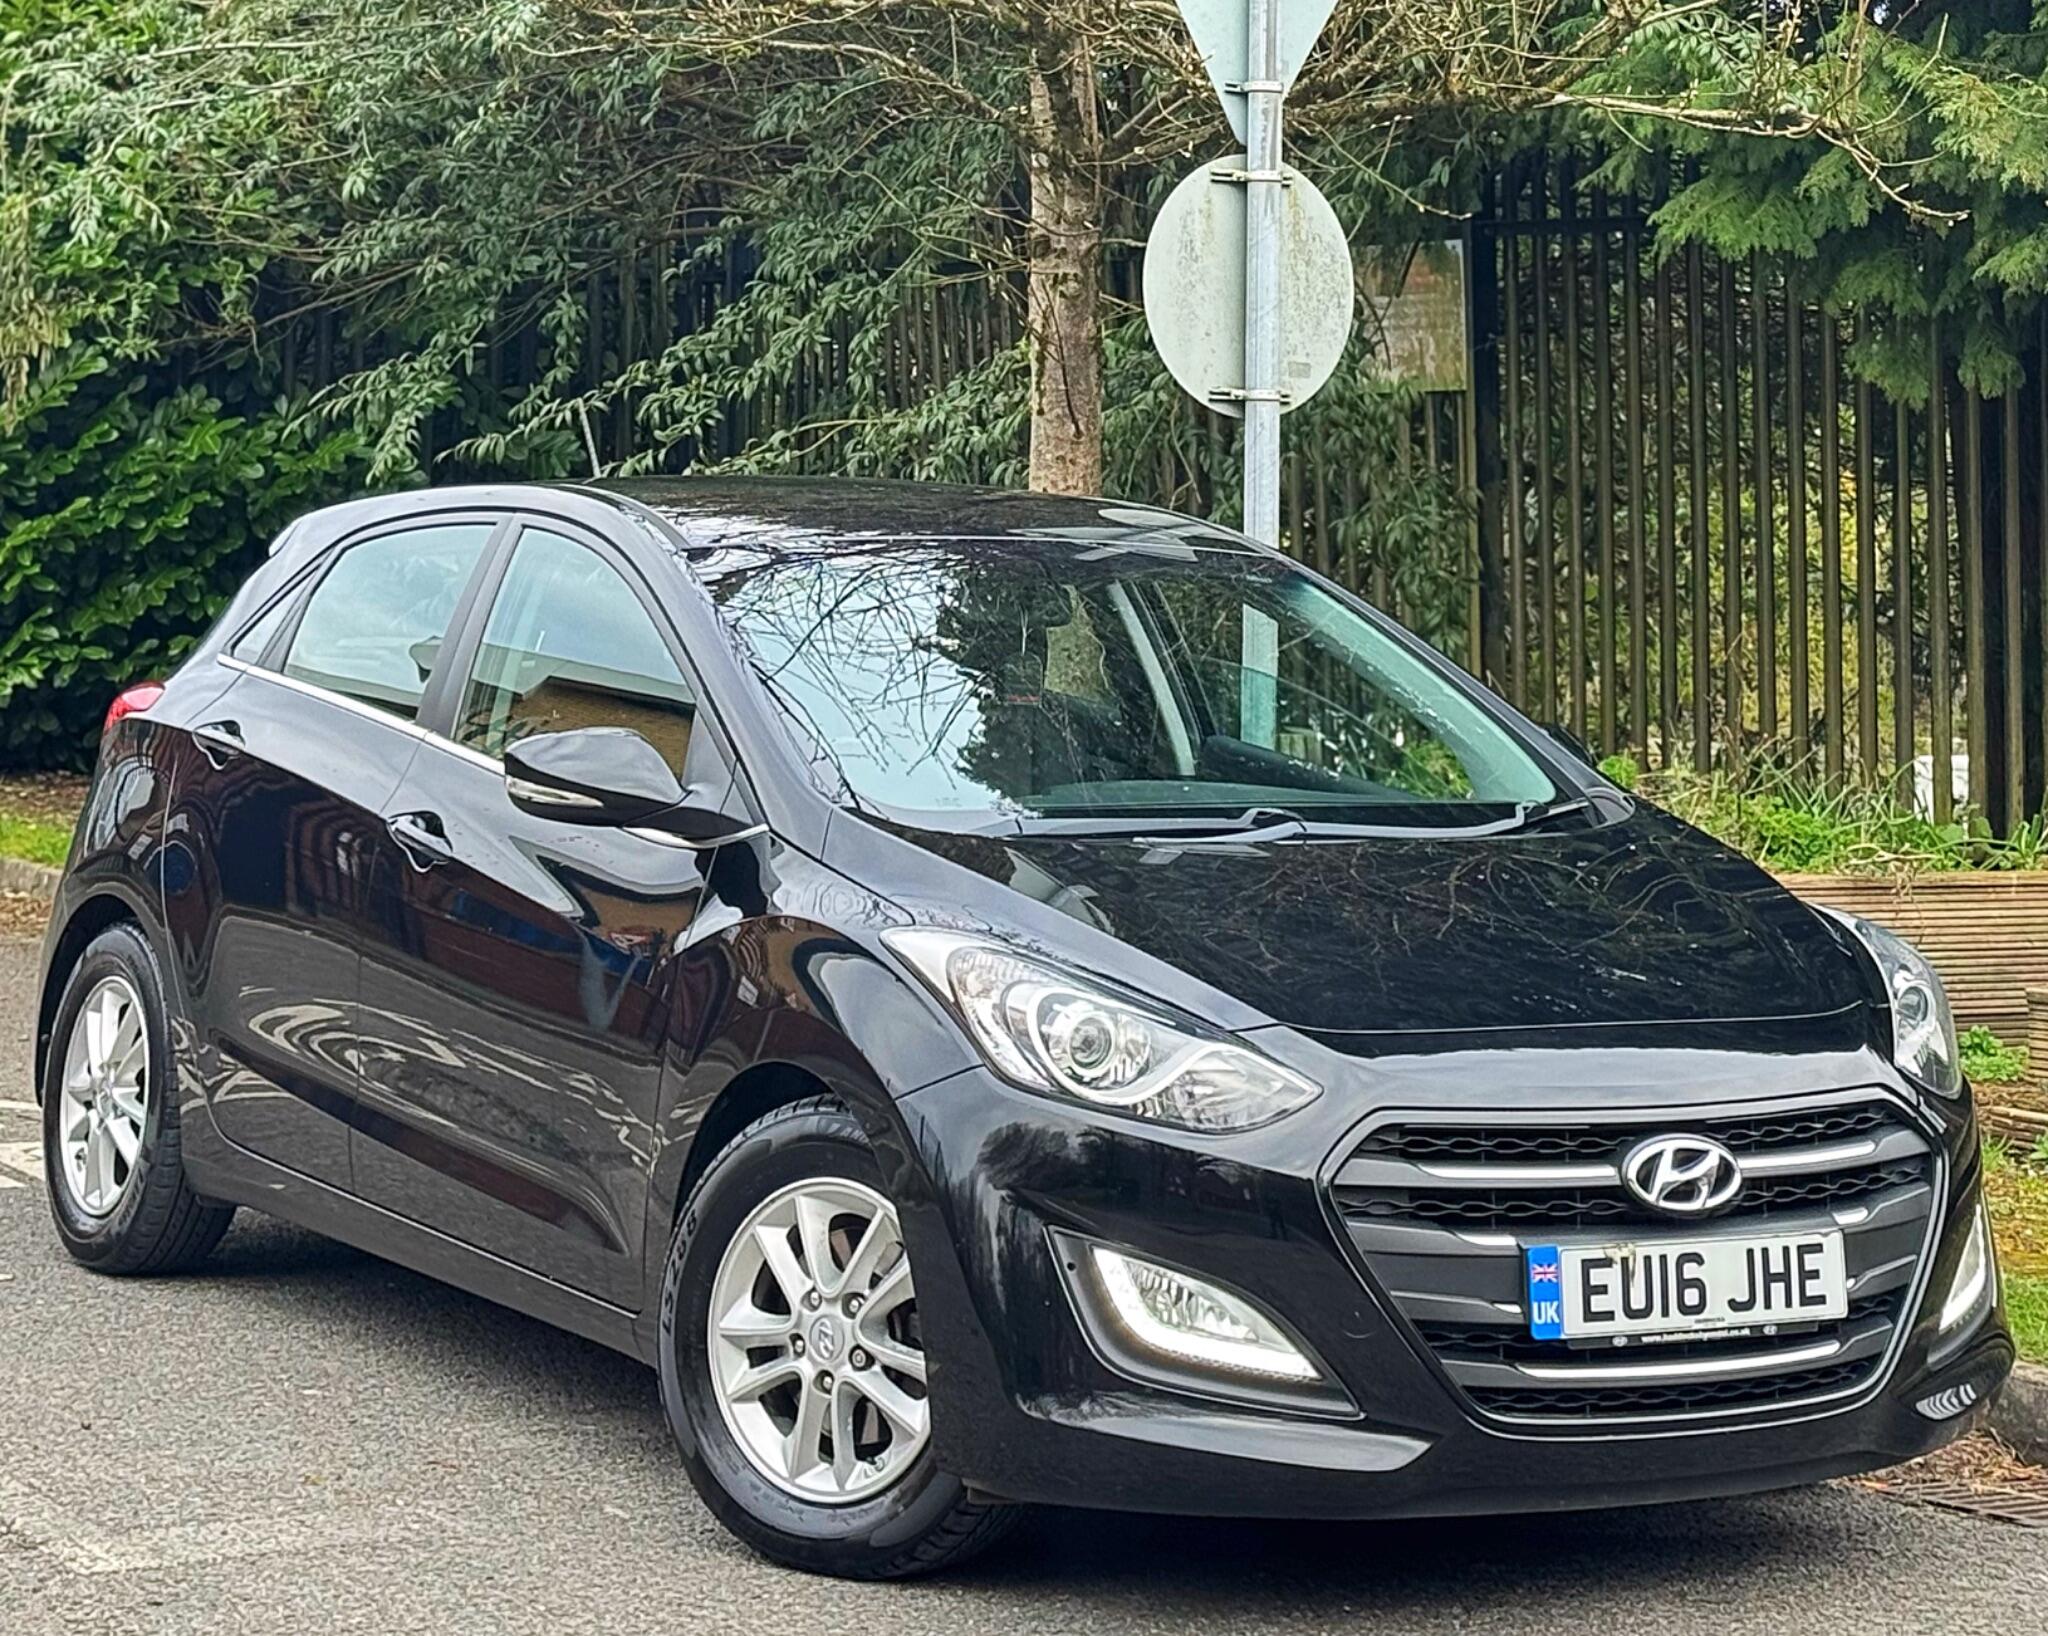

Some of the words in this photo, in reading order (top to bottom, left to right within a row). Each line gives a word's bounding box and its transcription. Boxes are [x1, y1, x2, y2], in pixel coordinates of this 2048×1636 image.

[1581, 1252, 1707, 1323] EU16
[1727, 1243, 1827, 1312] JHE
[1533, 1301, 1560, 1325] UK
